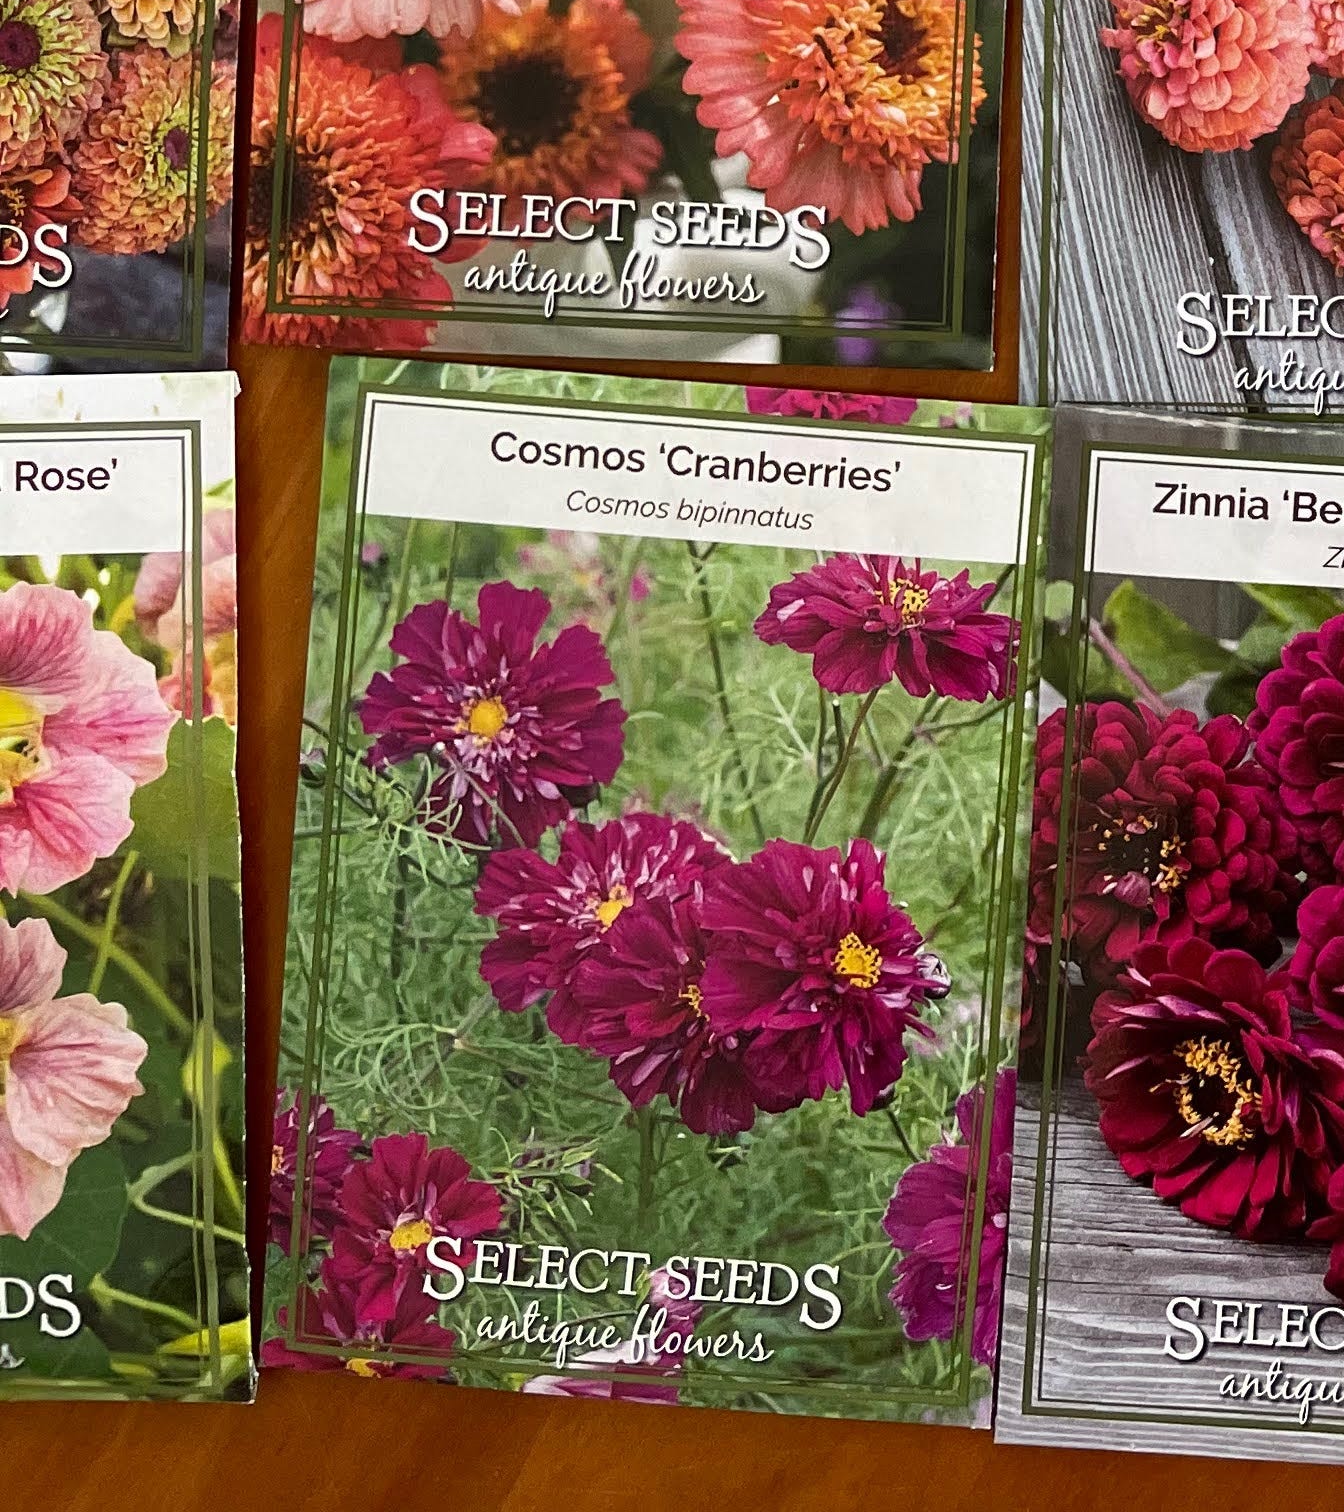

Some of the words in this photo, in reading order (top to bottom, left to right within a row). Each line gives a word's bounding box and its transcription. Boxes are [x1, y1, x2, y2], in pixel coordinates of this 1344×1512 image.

[408, 188, 635, 253] SELECT
[652, 201, 831, 269] SEEDS
[463, 250, 612, 317] antique
[620, 249, 765, 307] flowers
[15, 458, 118, 492] Rose’
[491, 432, 646, 473] Cosmos
[660, 443, 900, 492] ‘Cranberries’
[567, 490, 669, 520] Cosmos
[677, 498, 814, 531] bipinnatus
[1153, 482, 1269, 520] Zinnia
[422, 1237, 650, 1301] SELECT
[664, 1256, 842, 1329] SEEDS
[477, 1301, 622, 1368] antique
[631, 1304, 774, 1364] flowers
